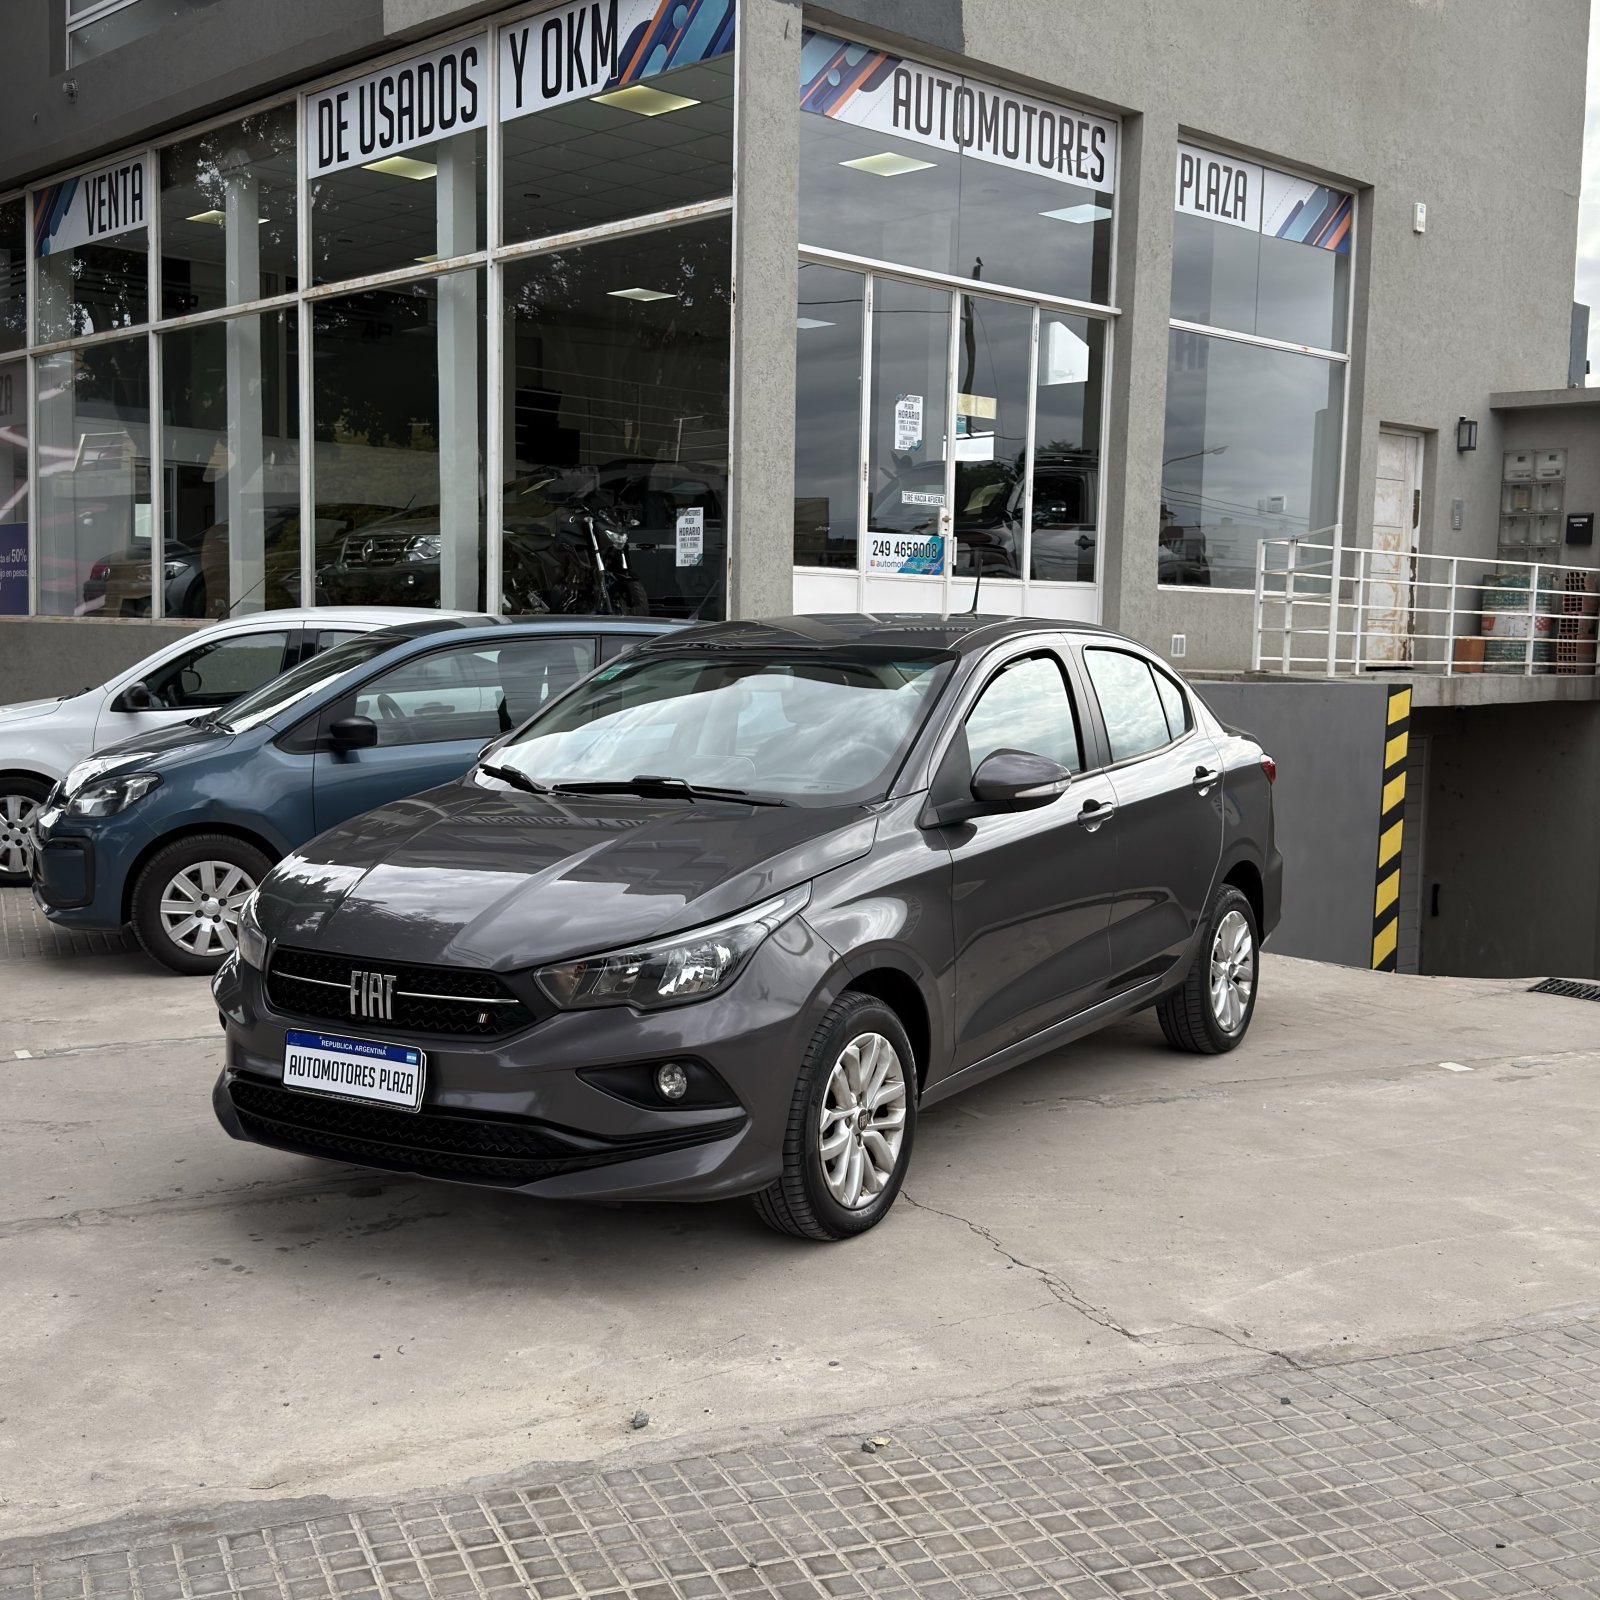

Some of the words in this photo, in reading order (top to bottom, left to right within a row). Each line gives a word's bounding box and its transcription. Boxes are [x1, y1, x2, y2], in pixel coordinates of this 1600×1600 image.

[318, 91, 349, 169] DE
[359, 46, 478, 155] USADOS
[509, 28, 529, 109] Y
[892, 67, 1106, 183] AUTOMOTORES
[1179, 153, 1248, 222] PLAZA
[85, 163, 143, 236] VENTA
[898, 410, 920, 420] HORARIO
[904, 494, 913, 502] TIRE
[914, 494, 927, 503] HACIA
[928, 495, 944, 504] AFUERA
[679, 526, 700, 536] HORARIO
[11, 548, 27, 562] 50%
[872, 540, 891, 556] 249
[894, 541, 937, 558] 4658008
[350, 970, 397, 1020] FIAT
[321, 1039, 353, 1050] REPUBLICA
[354, 1045, 387, 1056] ARGENTINA
[289, 1054, 376, 1088] AUTOMOTORES
[379, 1068, 414, 1095] PLAZA
